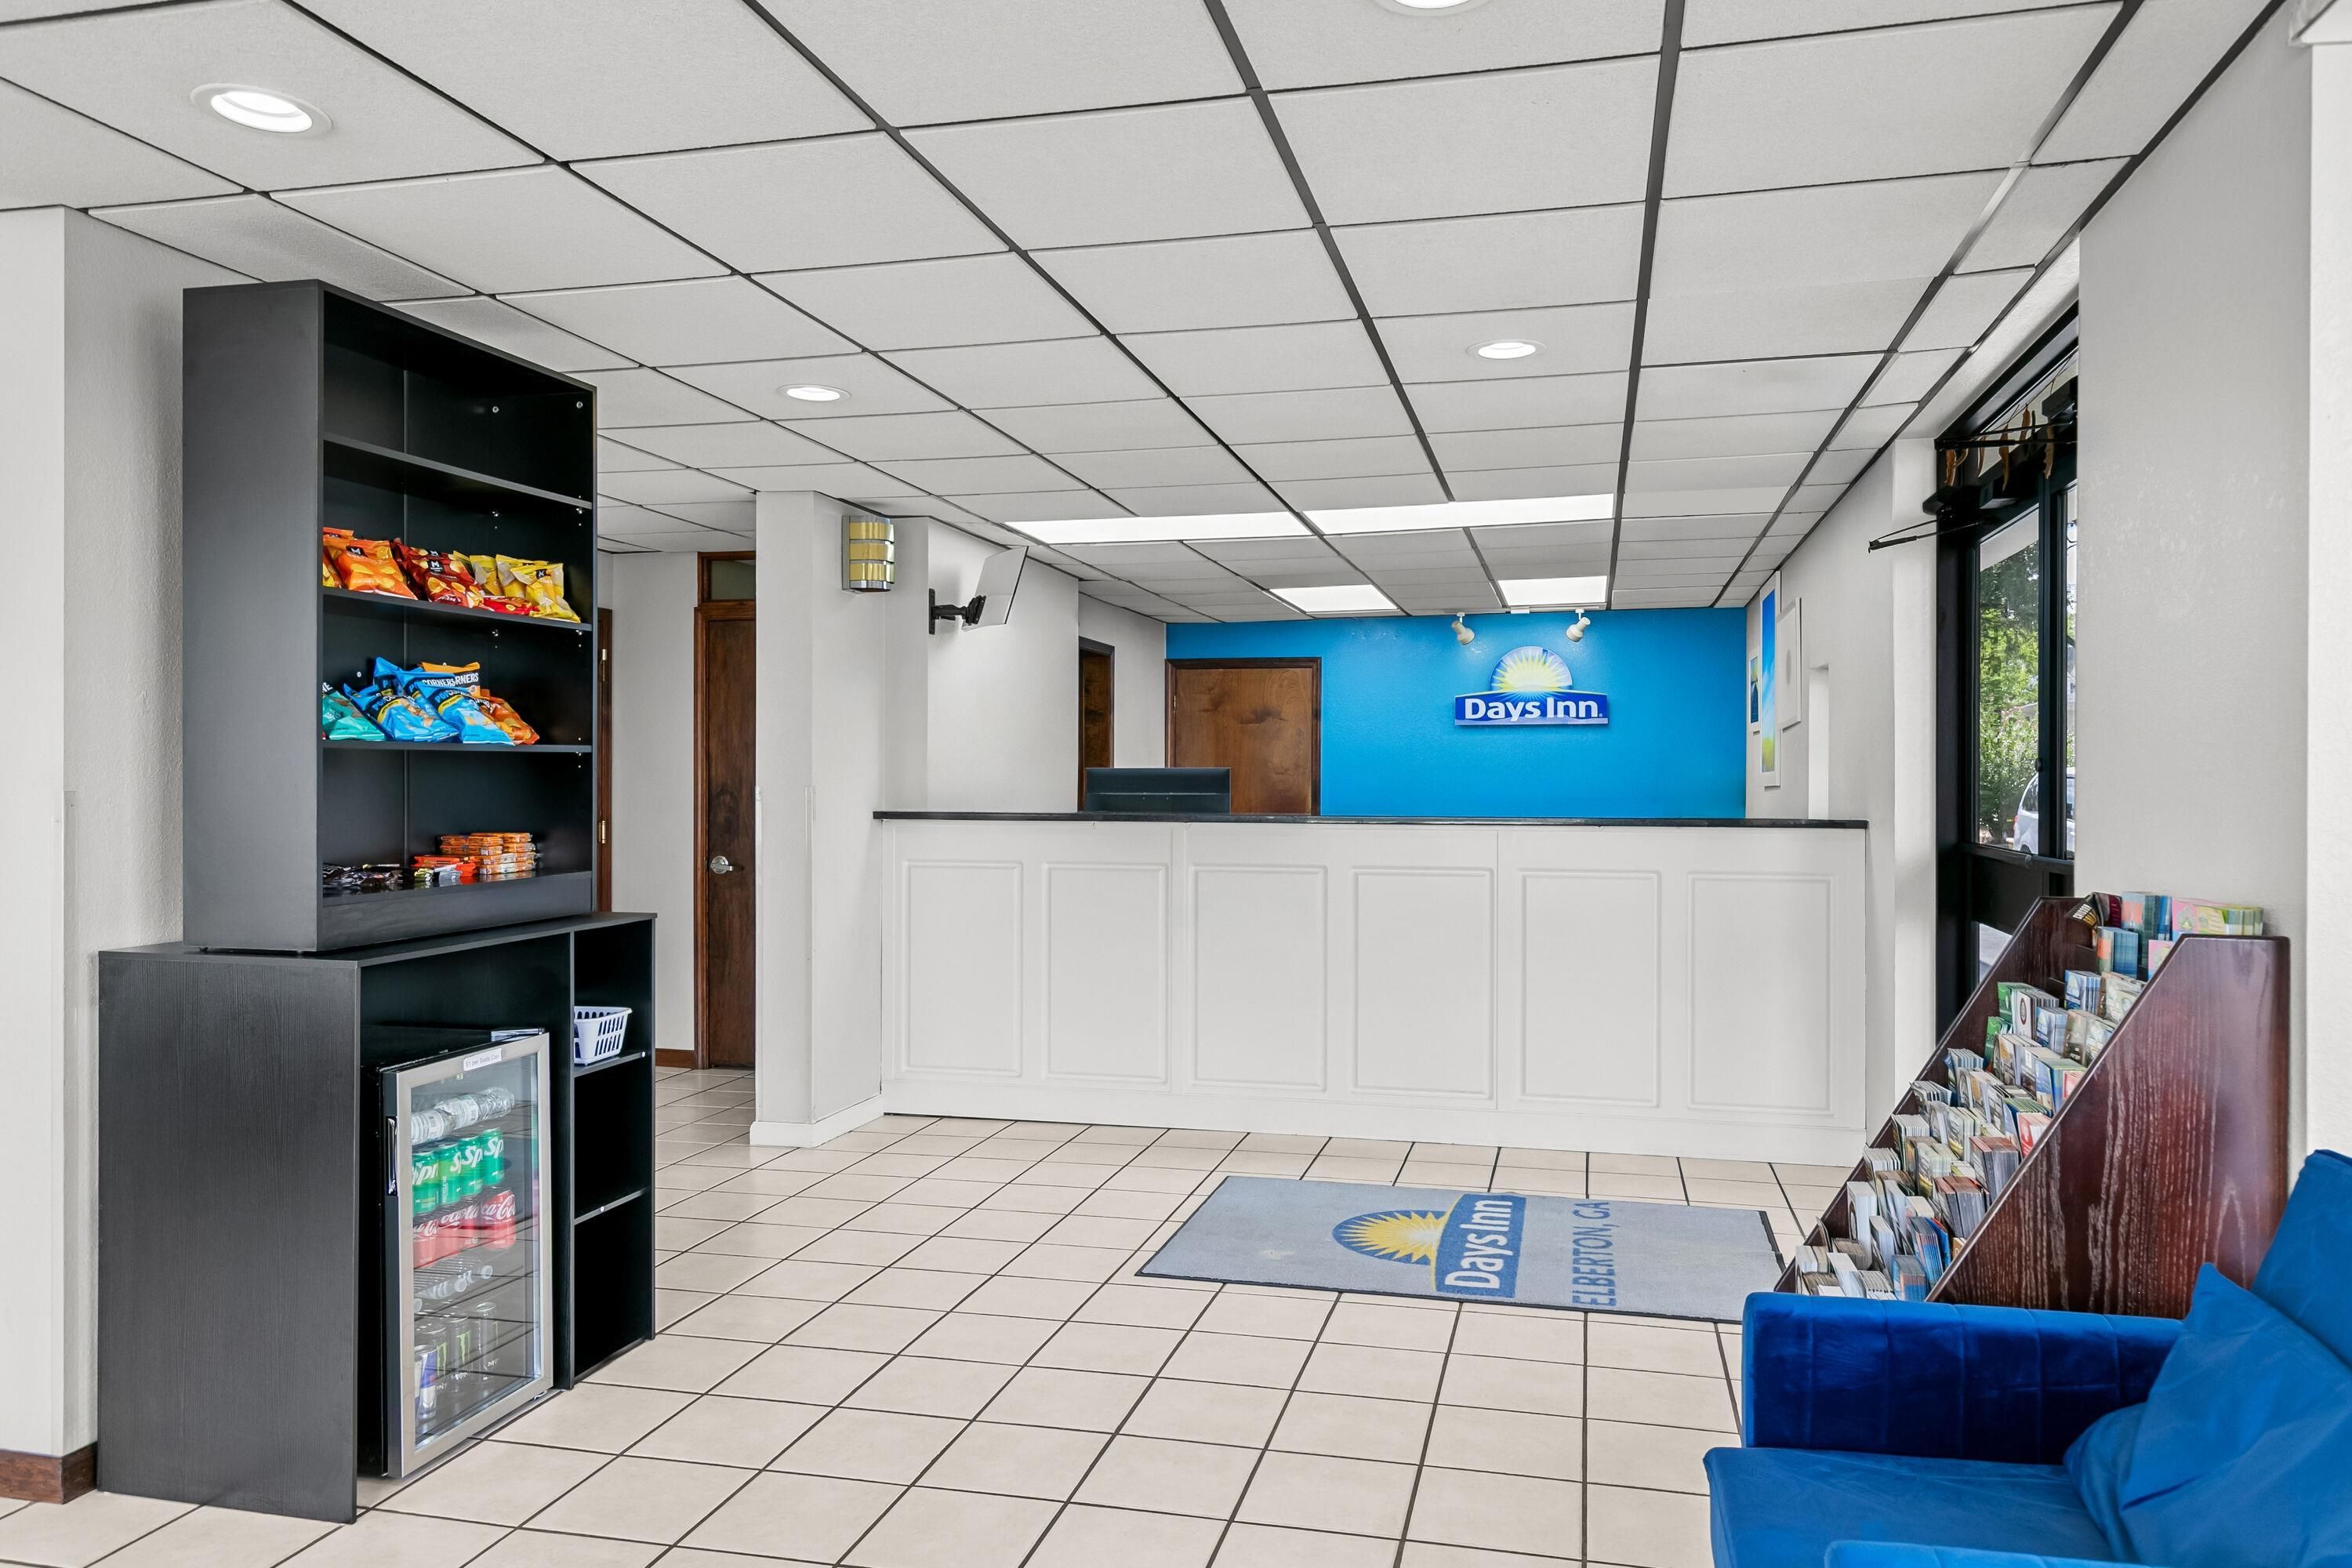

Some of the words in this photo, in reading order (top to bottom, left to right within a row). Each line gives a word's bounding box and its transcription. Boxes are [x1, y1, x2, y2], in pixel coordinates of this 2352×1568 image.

[1465, 698, 1541, 721] Days
[1547, 697, 1599, 718] Inn
[1459, 1200, 1513, 1232] Inn
[1573, 1202, 1612, 1220] GA
[1444, 1232, 1514, 1290] Days
[1571, 1224, 1621, 1307] ELBERTON,
